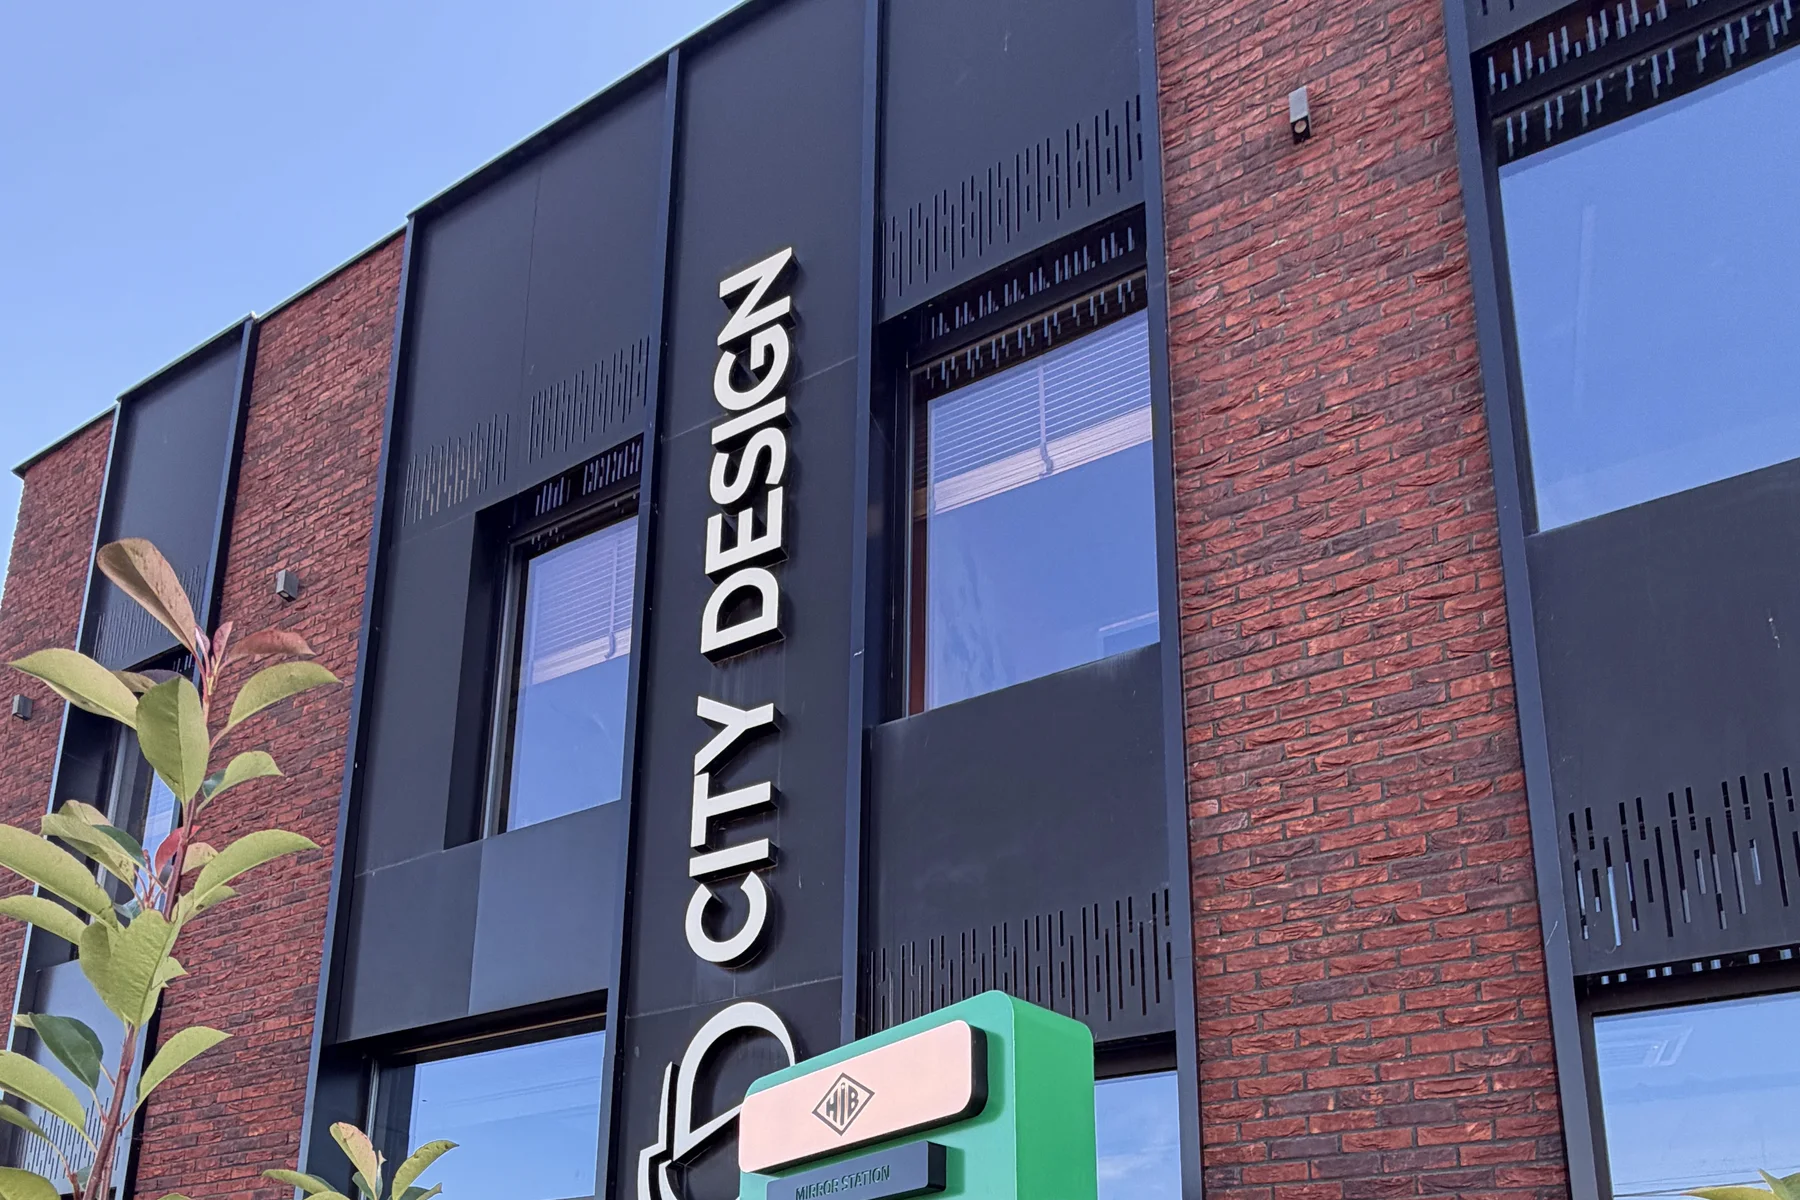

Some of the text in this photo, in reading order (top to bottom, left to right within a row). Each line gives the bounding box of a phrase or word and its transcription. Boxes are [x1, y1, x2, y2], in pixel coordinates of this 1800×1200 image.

[685, 246, 793, 963] CITY DESIGN
[841, 1164, 890, 1191] STATION
